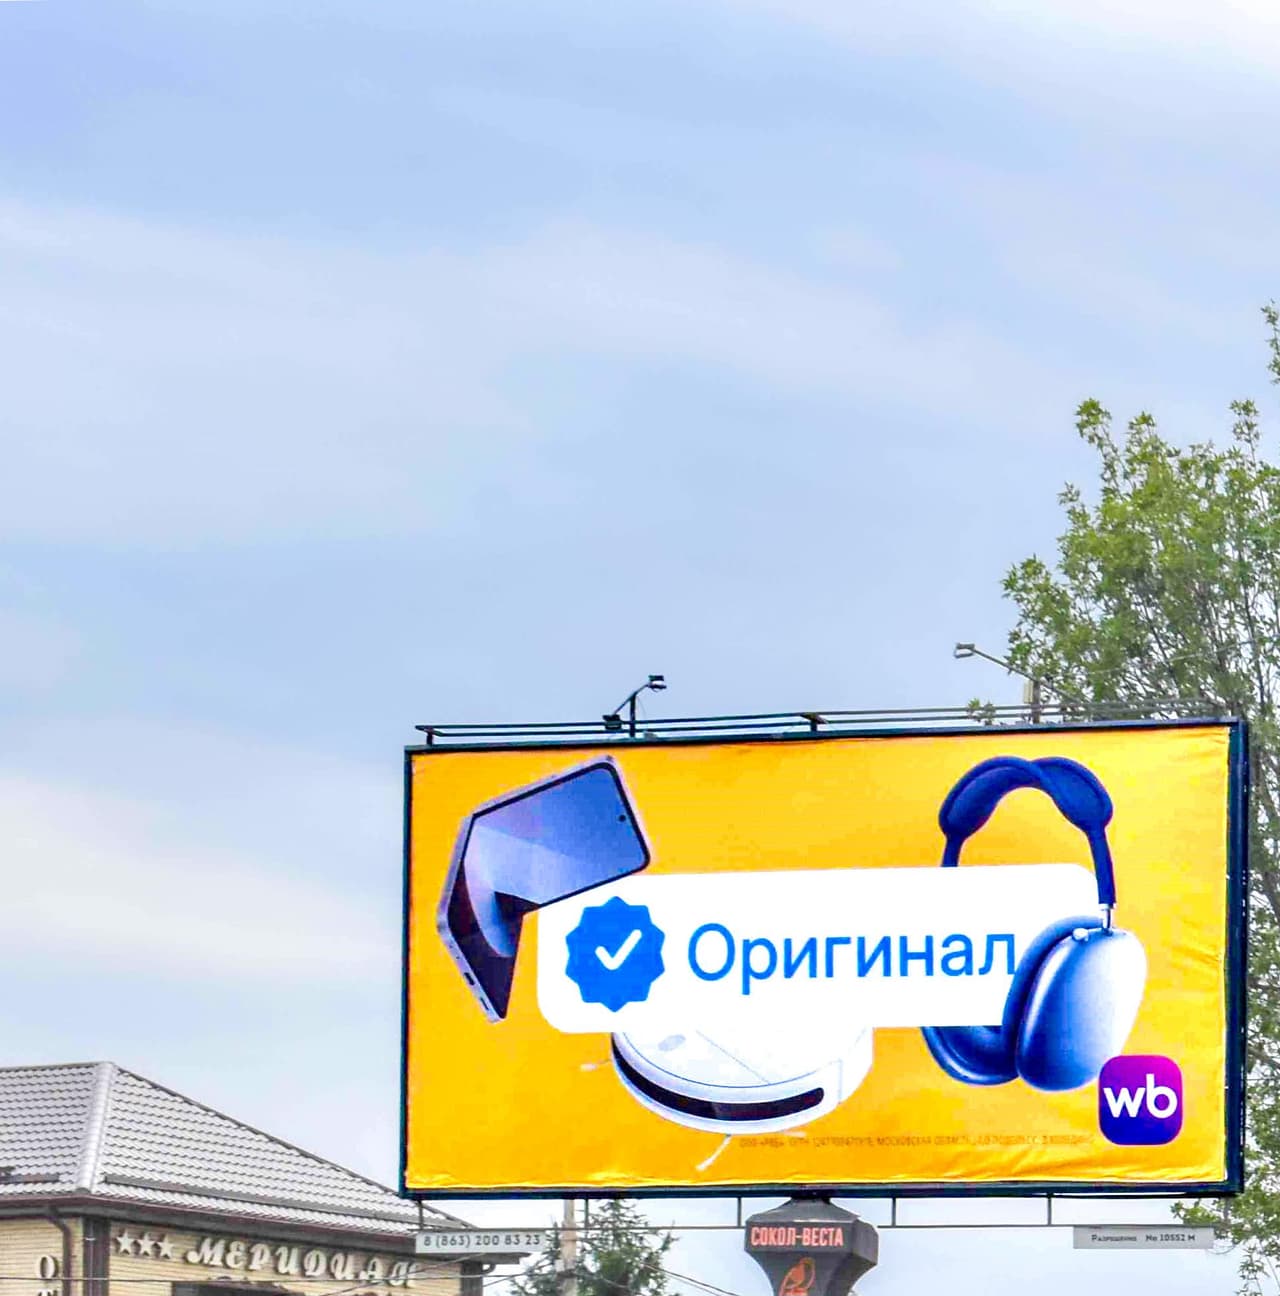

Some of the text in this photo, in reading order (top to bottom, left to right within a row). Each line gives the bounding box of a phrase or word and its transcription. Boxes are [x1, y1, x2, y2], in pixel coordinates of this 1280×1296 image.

[687, 922, 1016, 995] Оригинал
[1103, 1074, 1177, 1119] wb
[423, 1234, 540, 1248] 8 (863) 200 83 23
[751, 1226, 844, 1247] СОКОЛ-ВЕСТА
